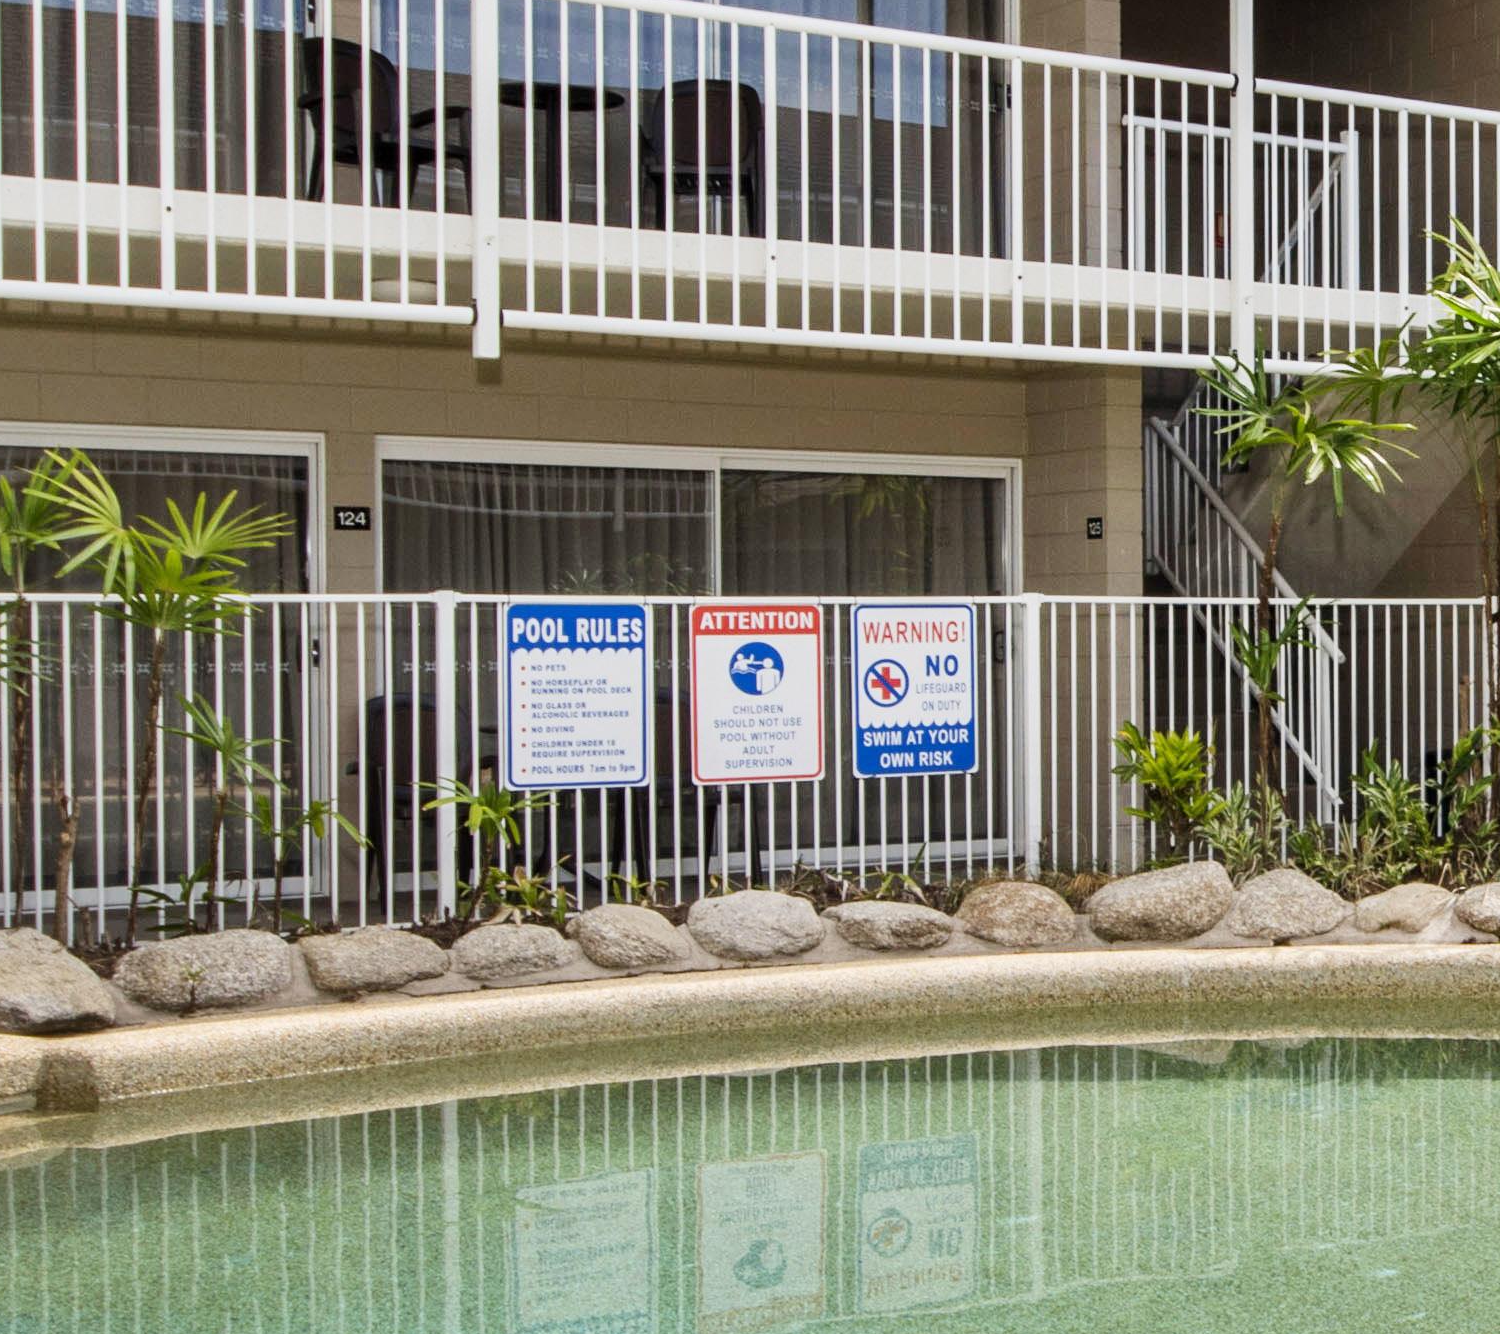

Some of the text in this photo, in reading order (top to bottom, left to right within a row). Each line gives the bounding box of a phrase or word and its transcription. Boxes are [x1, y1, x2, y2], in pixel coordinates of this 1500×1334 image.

[337, 511, 366, 526] 124
[700, 611, 813, 630] ATTENTION
[512, 617, 643, 643] POOL RULES
[863, 620, 966, 644] WARNING!
[545, 664, 566, 672] PETS
[925, 654, 959, 676] NO
[610, 686, 632, 694] DECK
[915, 683, 967, 694] LIFEGUARD
[732, 705, 784, 715] CHILDREN
[921, 700, 962, 711] ON DUTY
[532, 710, 629, 719] ALCOHOLIC BEVERAGES
[713, 717, 803, 729] SHOULD NOT USE
[546, 725, 575, 733] DIVING
[719, 731, 796, 742] POOL WITHOUT
[863, 728, 969, 747] SWIM AT YOUR
[532, 740, 573, 748] CHILDREN
[532, 749, 625, 758] REQUIRE SUPERVISION
[742, 745, 775, 755] ADULT
[724, 758, 793, 769] SUPERVISION
[879, 750, 953, 769] OWN RISK
[532, 766, 553, 774] POOL
[557, 765, 585, 773] HOURS
[609, 764, 617, 772] to
